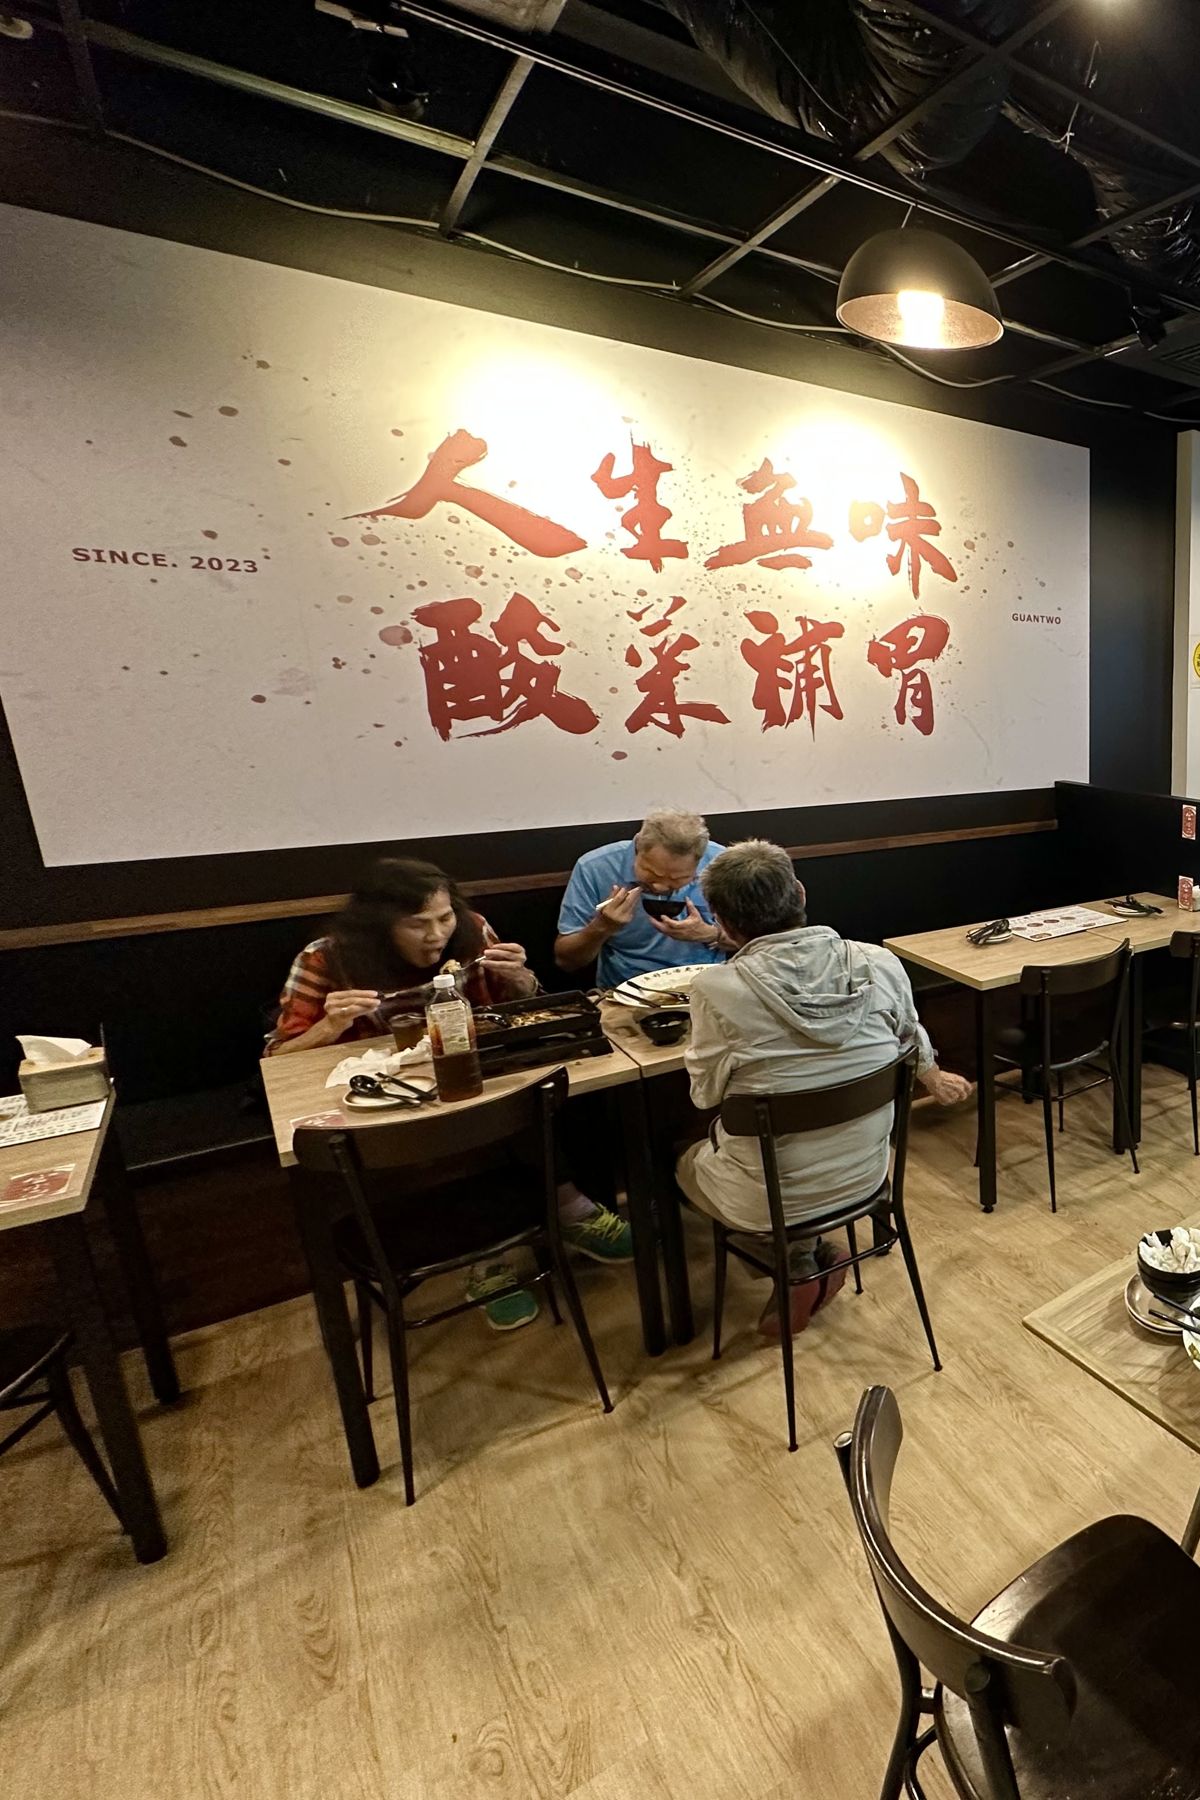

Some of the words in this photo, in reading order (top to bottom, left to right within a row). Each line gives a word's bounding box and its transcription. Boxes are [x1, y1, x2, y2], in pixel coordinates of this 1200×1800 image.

[71, 547, 178, 568] SINCE.
[189, 555, 259, 574] 2023
[1011, 612, 1062, 625] GUANTWO
[410, 592, 952, 742] 酸菜補胃
